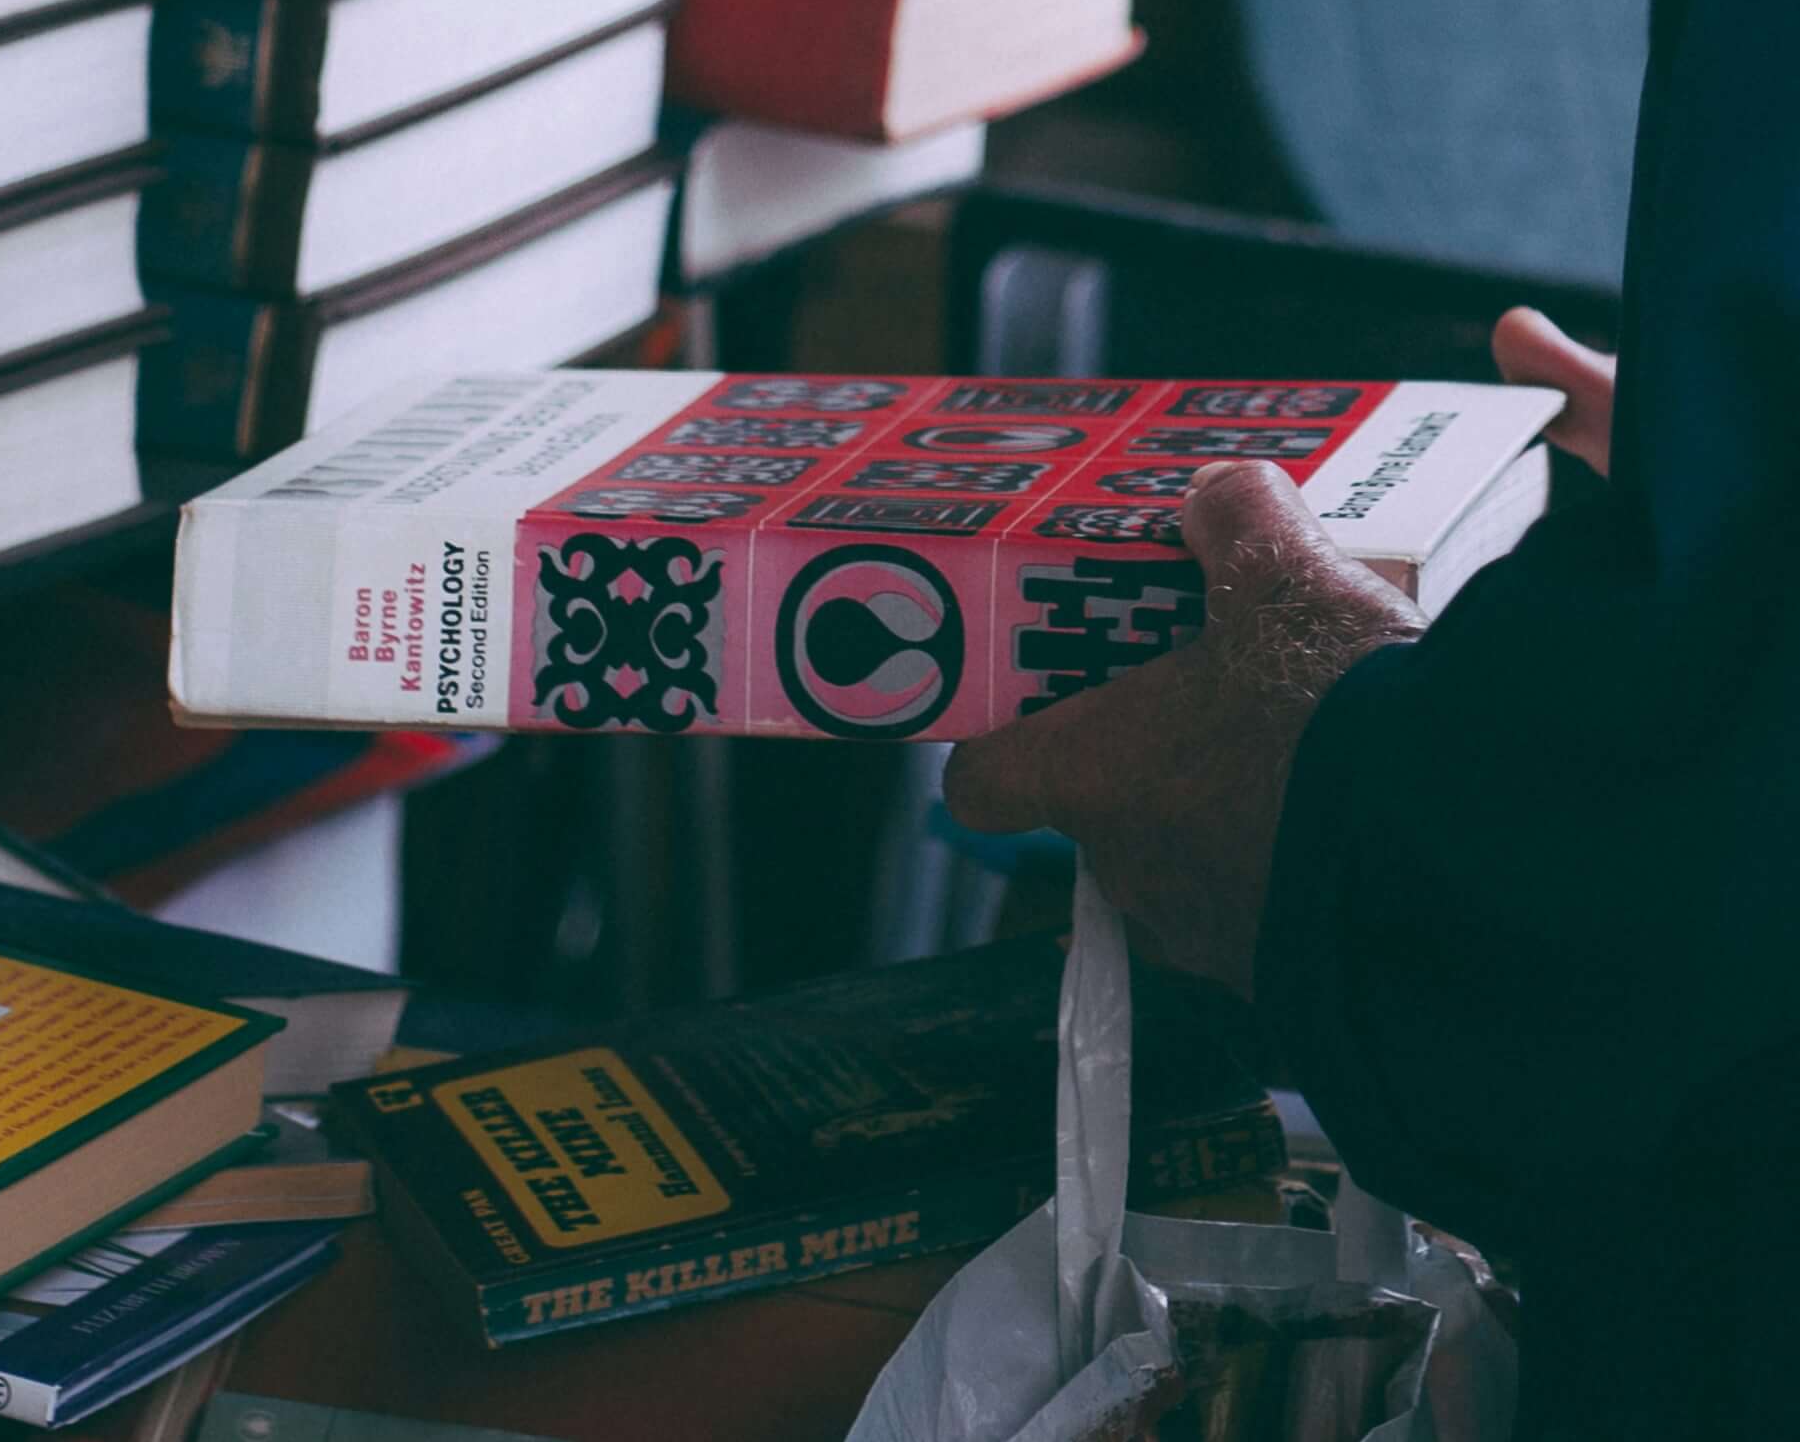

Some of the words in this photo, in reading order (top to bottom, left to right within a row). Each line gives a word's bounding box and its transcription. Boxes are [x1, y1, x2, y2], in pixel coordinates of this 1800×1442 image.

[1319, 491, 1386, 519] Baron
[471, 551, 490, 623] Edition
[348, 587, 372, 661] Baron
[375, 589, 401, 662] Byrne
[401, 563, 426, 692] Kantowitz
[437, 541, 465, 714] PSYCHOLOGY
[466, 628, 488, 708] Second
[459, 1086, 560, 1174] KILLER
[536, 1106, 627, 1179] MINE
[460, 1188, 495, 1220] PAN
[526, 1174, 601, 1234] THE
[486, 1220, 532, 1266] GREAT
[522, 1276, 614, 1324] THE
[626, 1241, 788, 1305] KILLER
[799, 1210, 921, 1266] MINE
